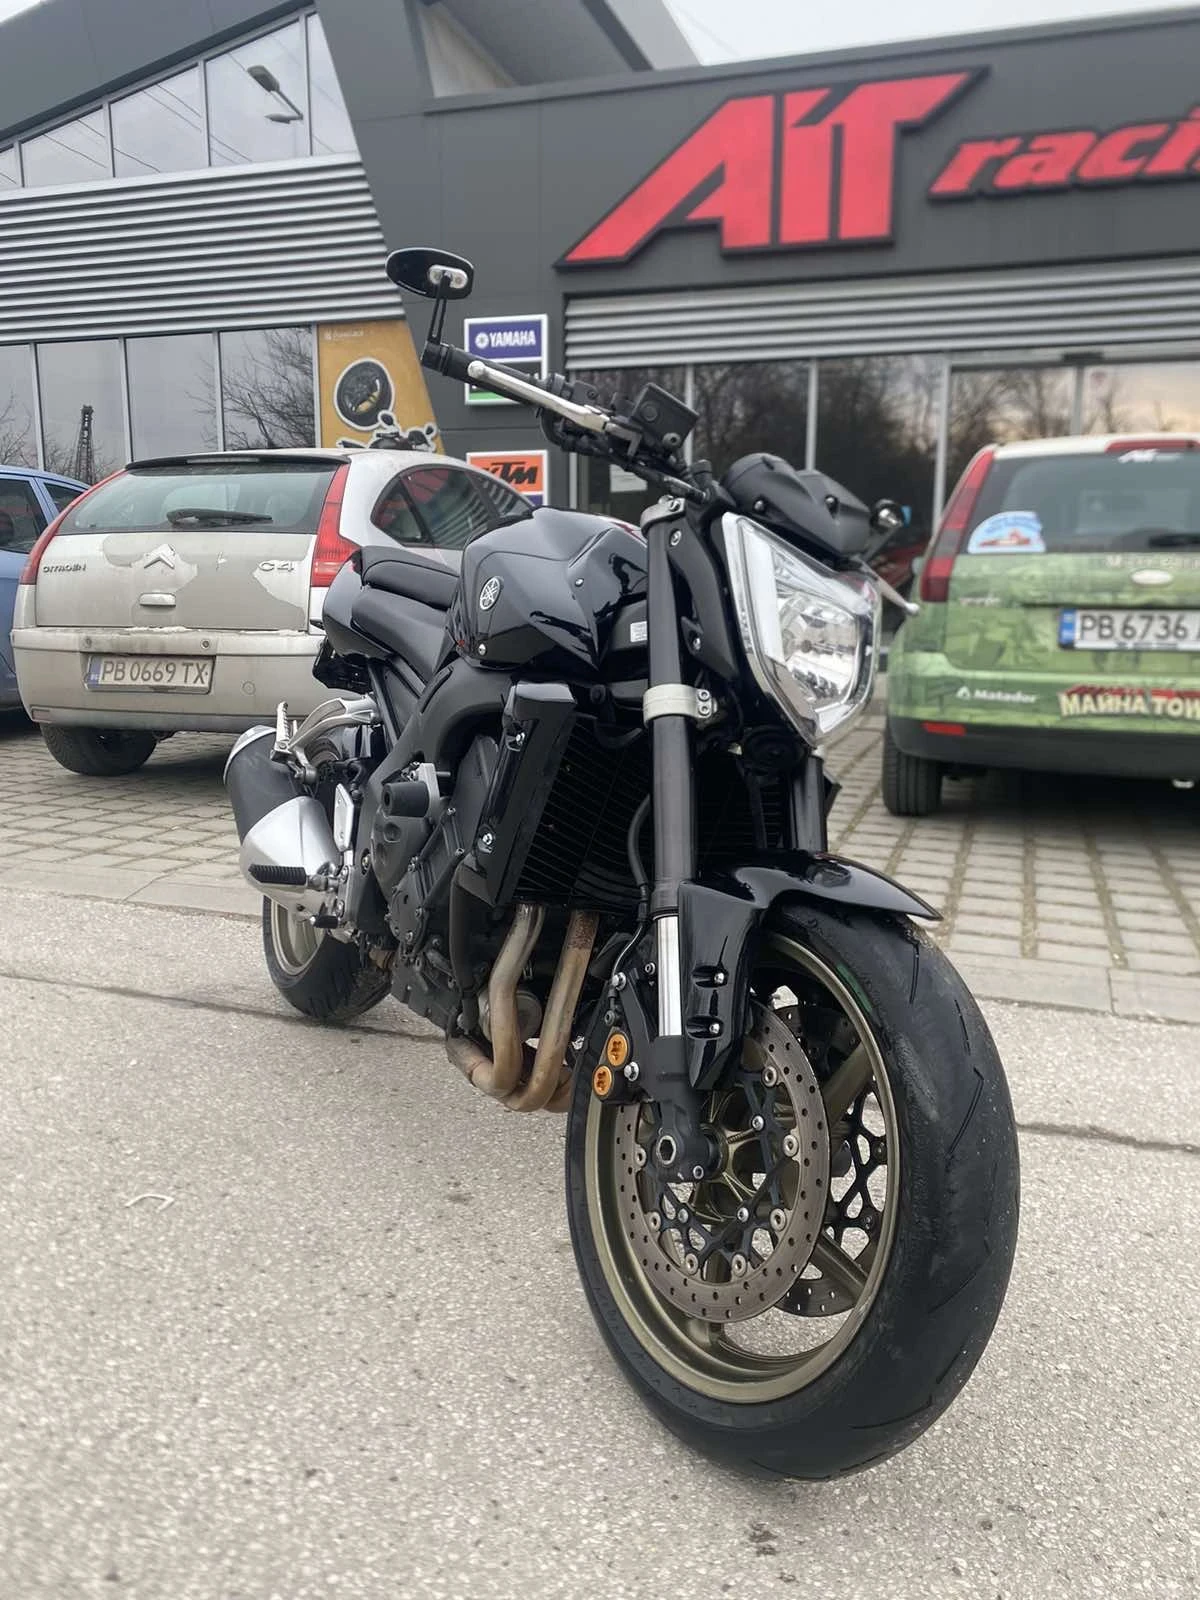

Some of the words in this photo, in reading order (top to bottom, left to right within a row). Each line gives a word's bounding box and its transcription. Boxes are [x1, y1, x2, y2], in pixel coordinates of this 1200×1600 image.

[928, 105, 1200, 194] raci
[489, 330, 537, 348] YAMAHA
[1121, 612, 1189, 640] 6736
[101, 660, 126, 681] PB
[129, 661, 177, 683] 0669
[181, 662, 207, 684] TX
[974, 689, 1037, 704] Matador
